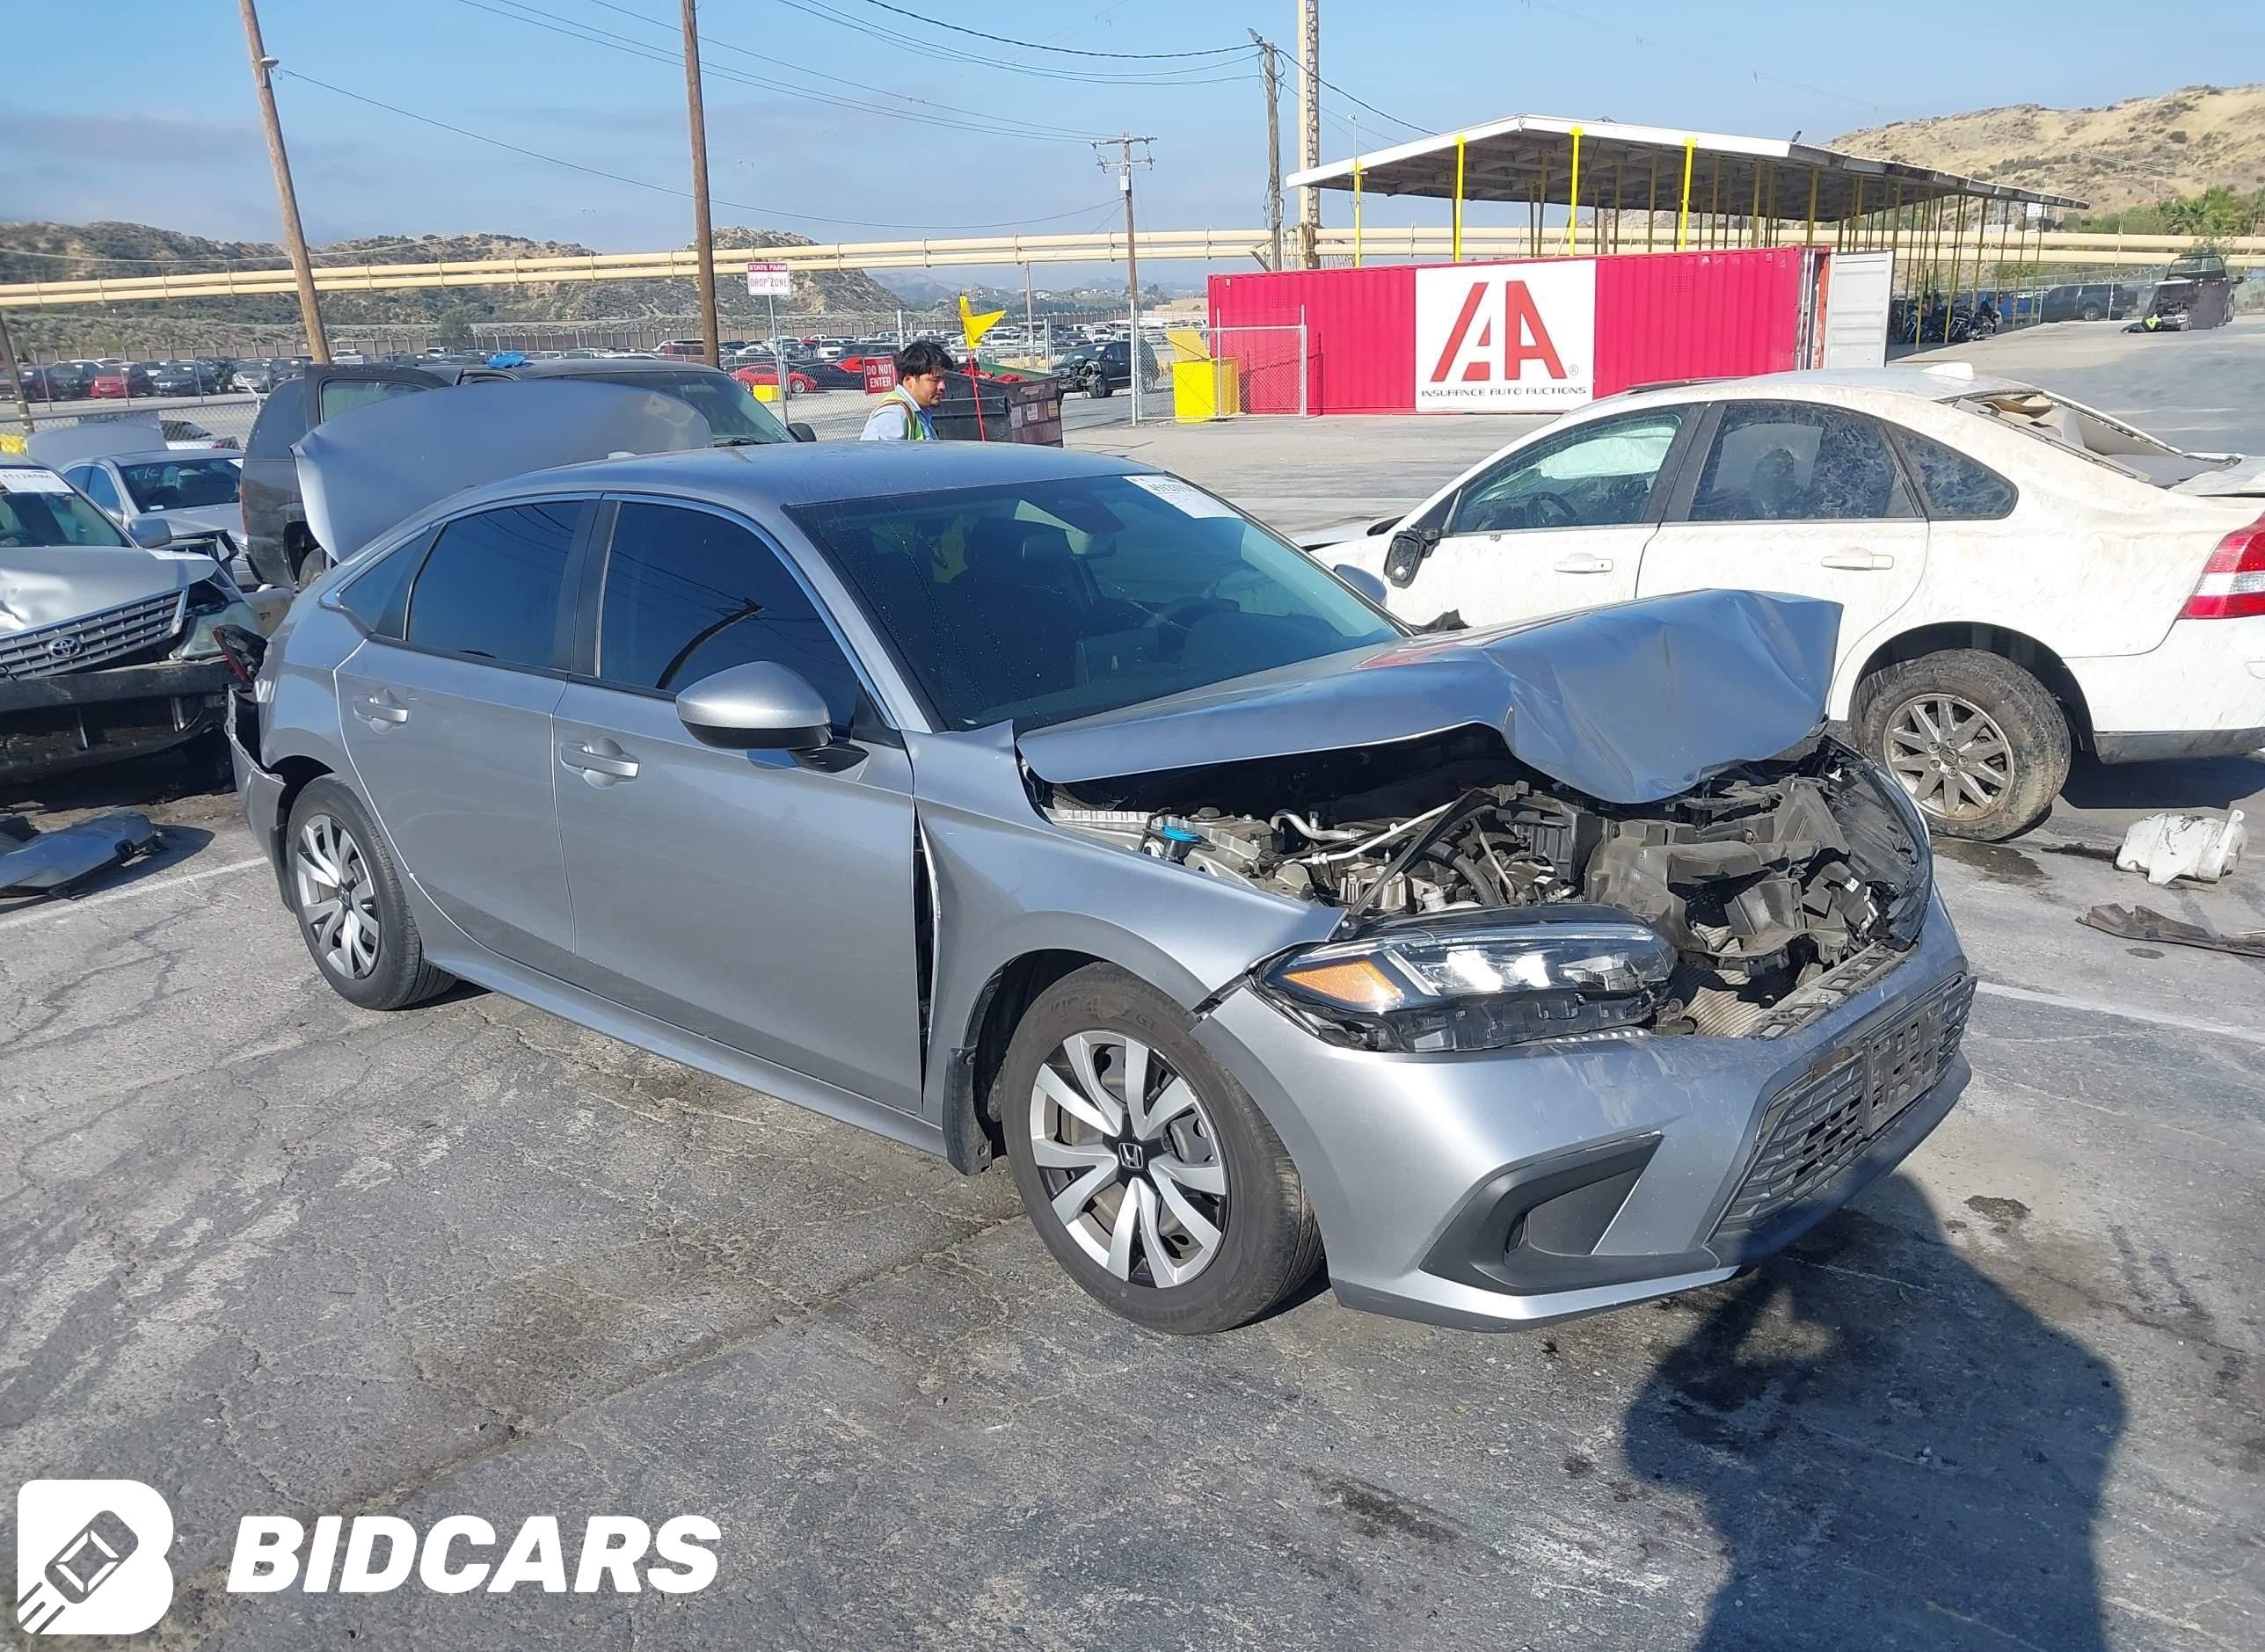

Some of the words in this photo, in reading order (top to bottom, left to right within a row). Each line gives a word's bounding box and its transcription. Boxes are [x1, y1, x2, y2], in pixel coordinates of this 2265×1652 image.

[750, 278, 768, 287] DROP
[770, 277, 787, 287] ZONE
[866, 365, 877, 375] DO
[878, 363, 892, 375] NOT
[870, 377, 892, 388] ENTER
[1421, 389, 1486, 397] INSURANCE
[1489, 387, 1522, 396] AUTO
[1526, 386, 1587, 395] AUCTIONS
